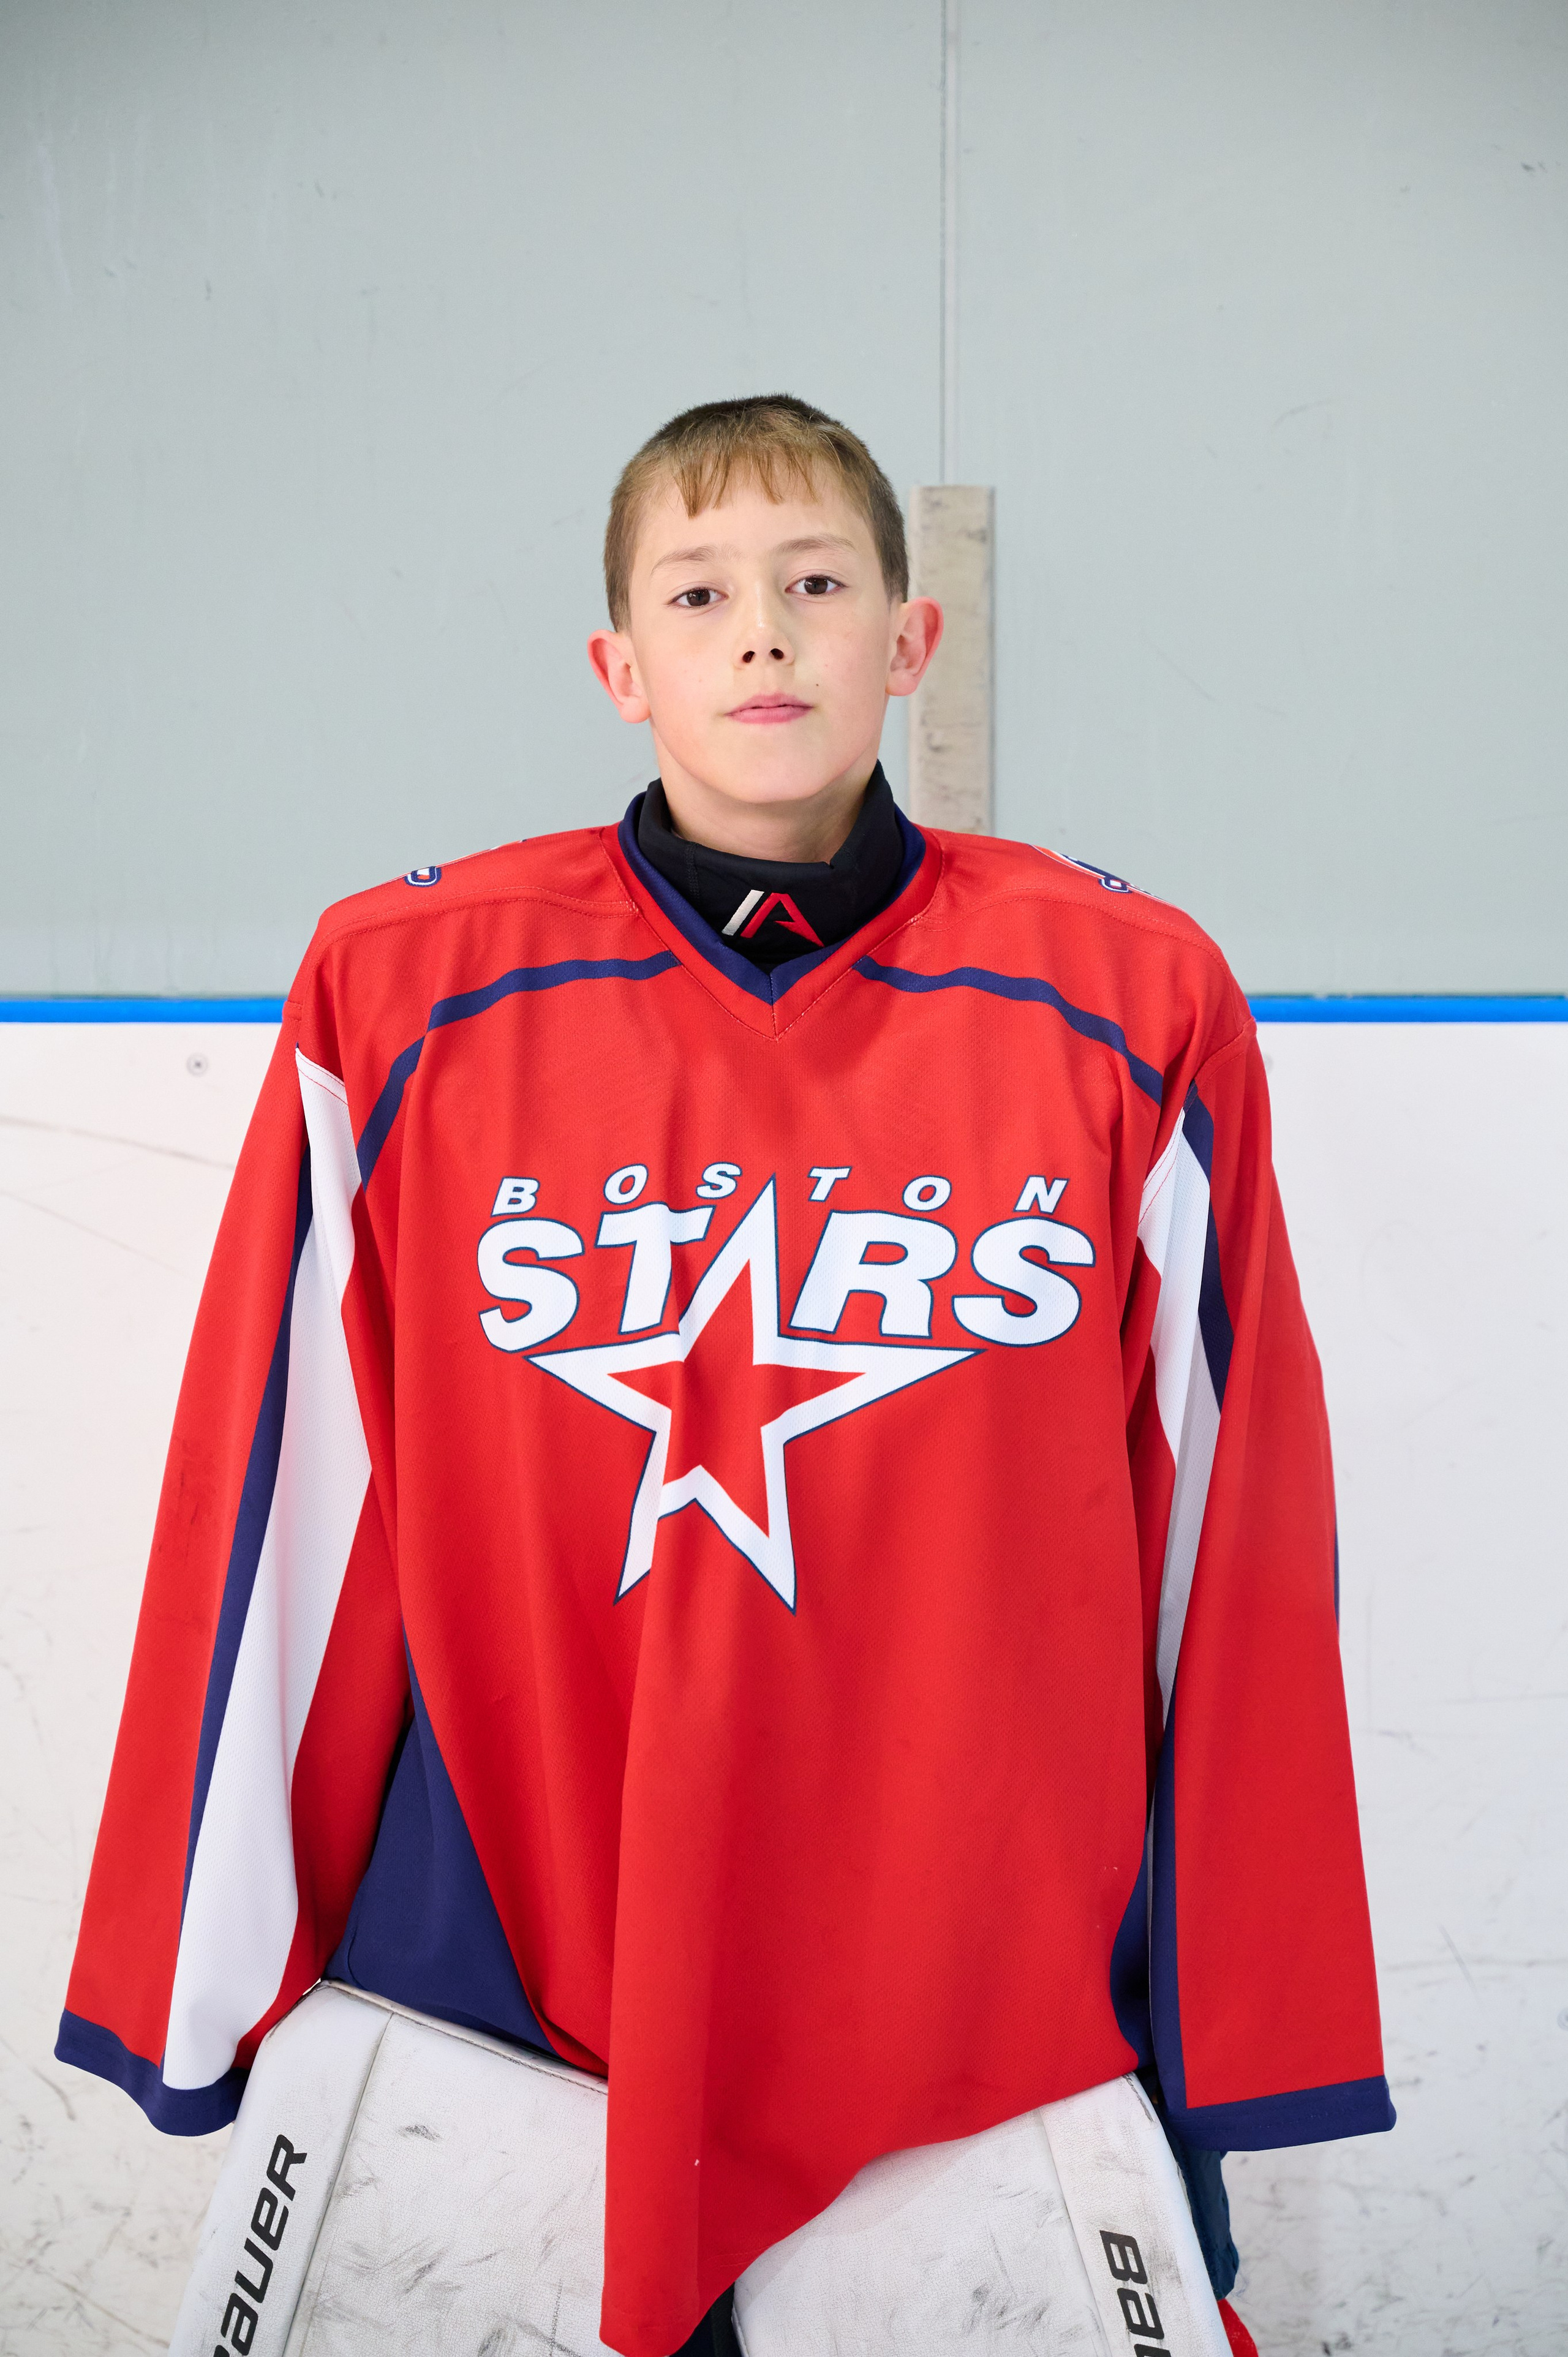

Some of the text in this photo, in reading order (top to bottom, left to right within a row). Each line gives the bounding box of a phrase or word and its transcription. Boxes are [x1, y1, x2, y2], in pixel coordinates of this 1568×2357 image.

[477, 1174, 1095, 1351] STARS
[492, 1163, 1068, 1215] BOSTON
[213, 2134, 307, 2357] AUER
